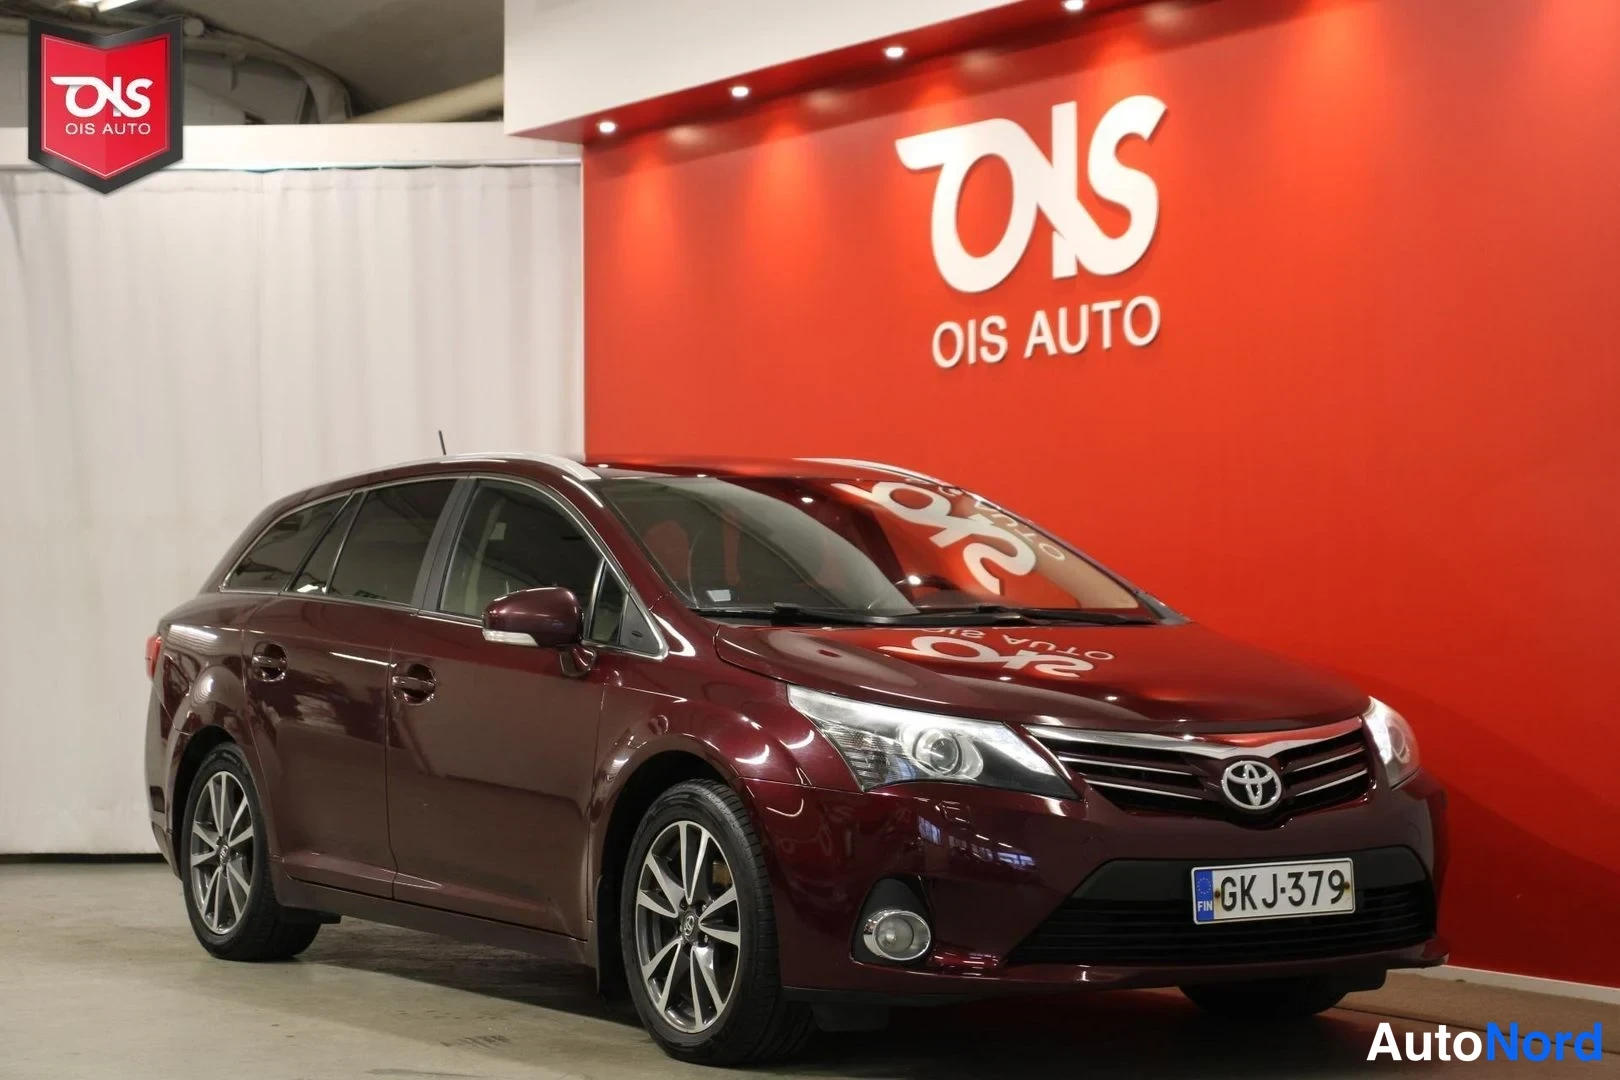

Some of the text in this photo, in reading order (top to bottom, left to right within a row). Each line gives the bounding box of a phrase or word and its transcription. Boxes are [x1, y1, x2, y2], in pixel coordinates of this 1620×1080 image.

[895, 95, 1168, 293] OIS
[932, 295, 1161, 369] OIS AUTO
[1197, 900, 1213, 912] FIN
[1220, 869, 1346, 912] GKJ-379
